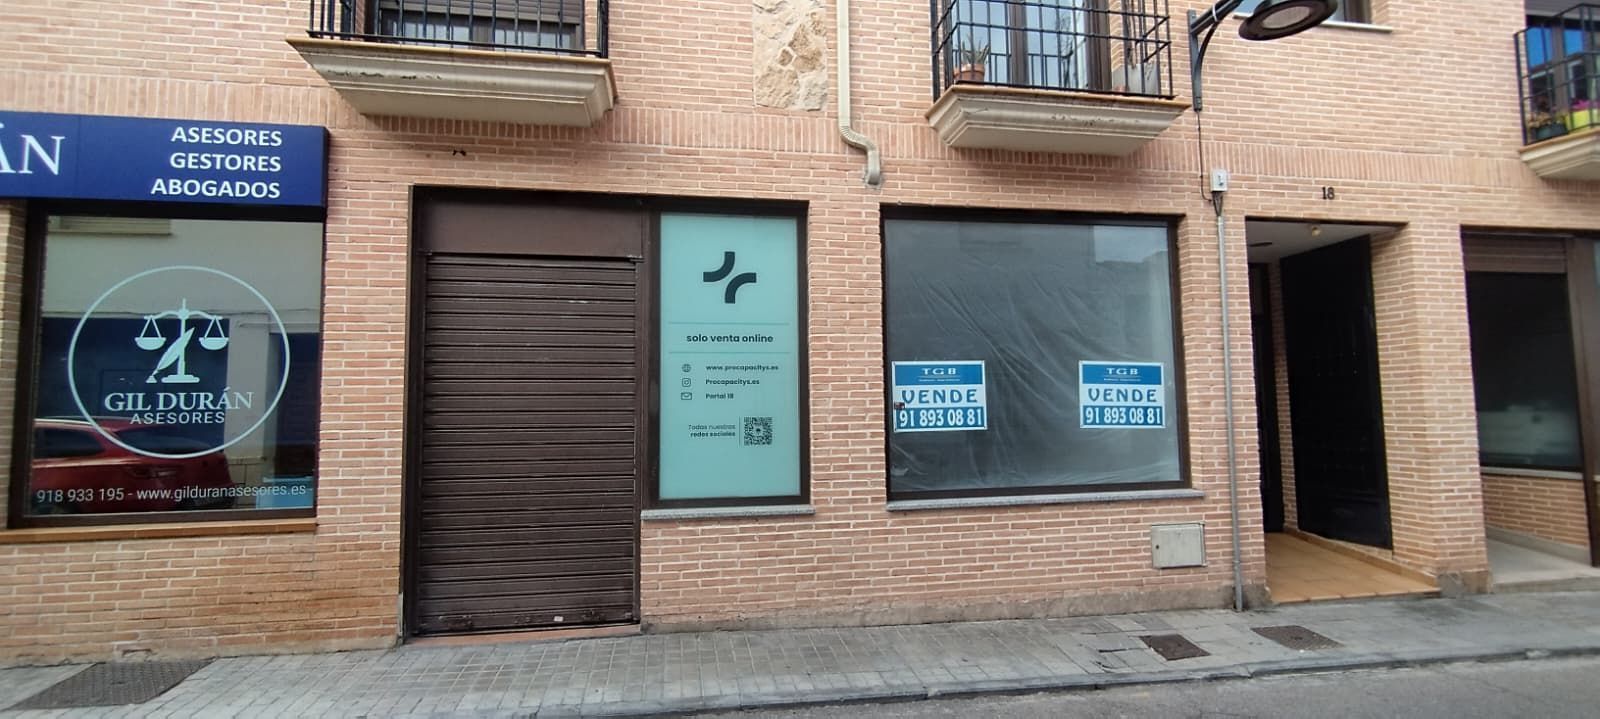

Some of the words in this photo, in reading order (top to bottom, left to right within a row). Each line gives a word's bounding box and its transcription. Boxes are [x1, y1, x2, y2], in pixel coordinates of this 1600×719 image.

[170, 126, 283, 147] ASESORES
[169, 152, 282, 173] GESTORES
[150, 178, 281, 199] ABOGADOS
[1322, 186, 1335, 200] 18
[686, 333, 708, 342] solo
[710, 334, 740, 342] venta
[741, 333, 774, 343] online
[705, 364, 779, 372] www.procapacitys.es
[921, 367, 957, 375] TGB
[1106, 367, 1139, 375] TGB
[705, 378, 760, 386] Procapacitys.es
[104, 392, 151, 411] GIL
[156, 386, 254, 411] DURÁN
[901, 388, 978, 404] VENDE
[1088, 387, 1157, 402] VENDE
[130, 411, 225, 425] ASESORES
[899, 410, 915, 427] 91
[919, 409, 945, 427] 893
[947, 408, 964, 426] 08
[966, 408, 982, 426] 81
[1085, 406, 1100, 424] 91
[1103, 406, 1127, 424] 893
[1129, 407, 1145, 424] 08
[1146, 407, 1161, 425] 81
[36, 489, 64, 503] 918
[67, 488, 94, 502] 933
[100, 487, 124, 501] 195
[136, 483, 306, 502] www.gilduranasesores.es
